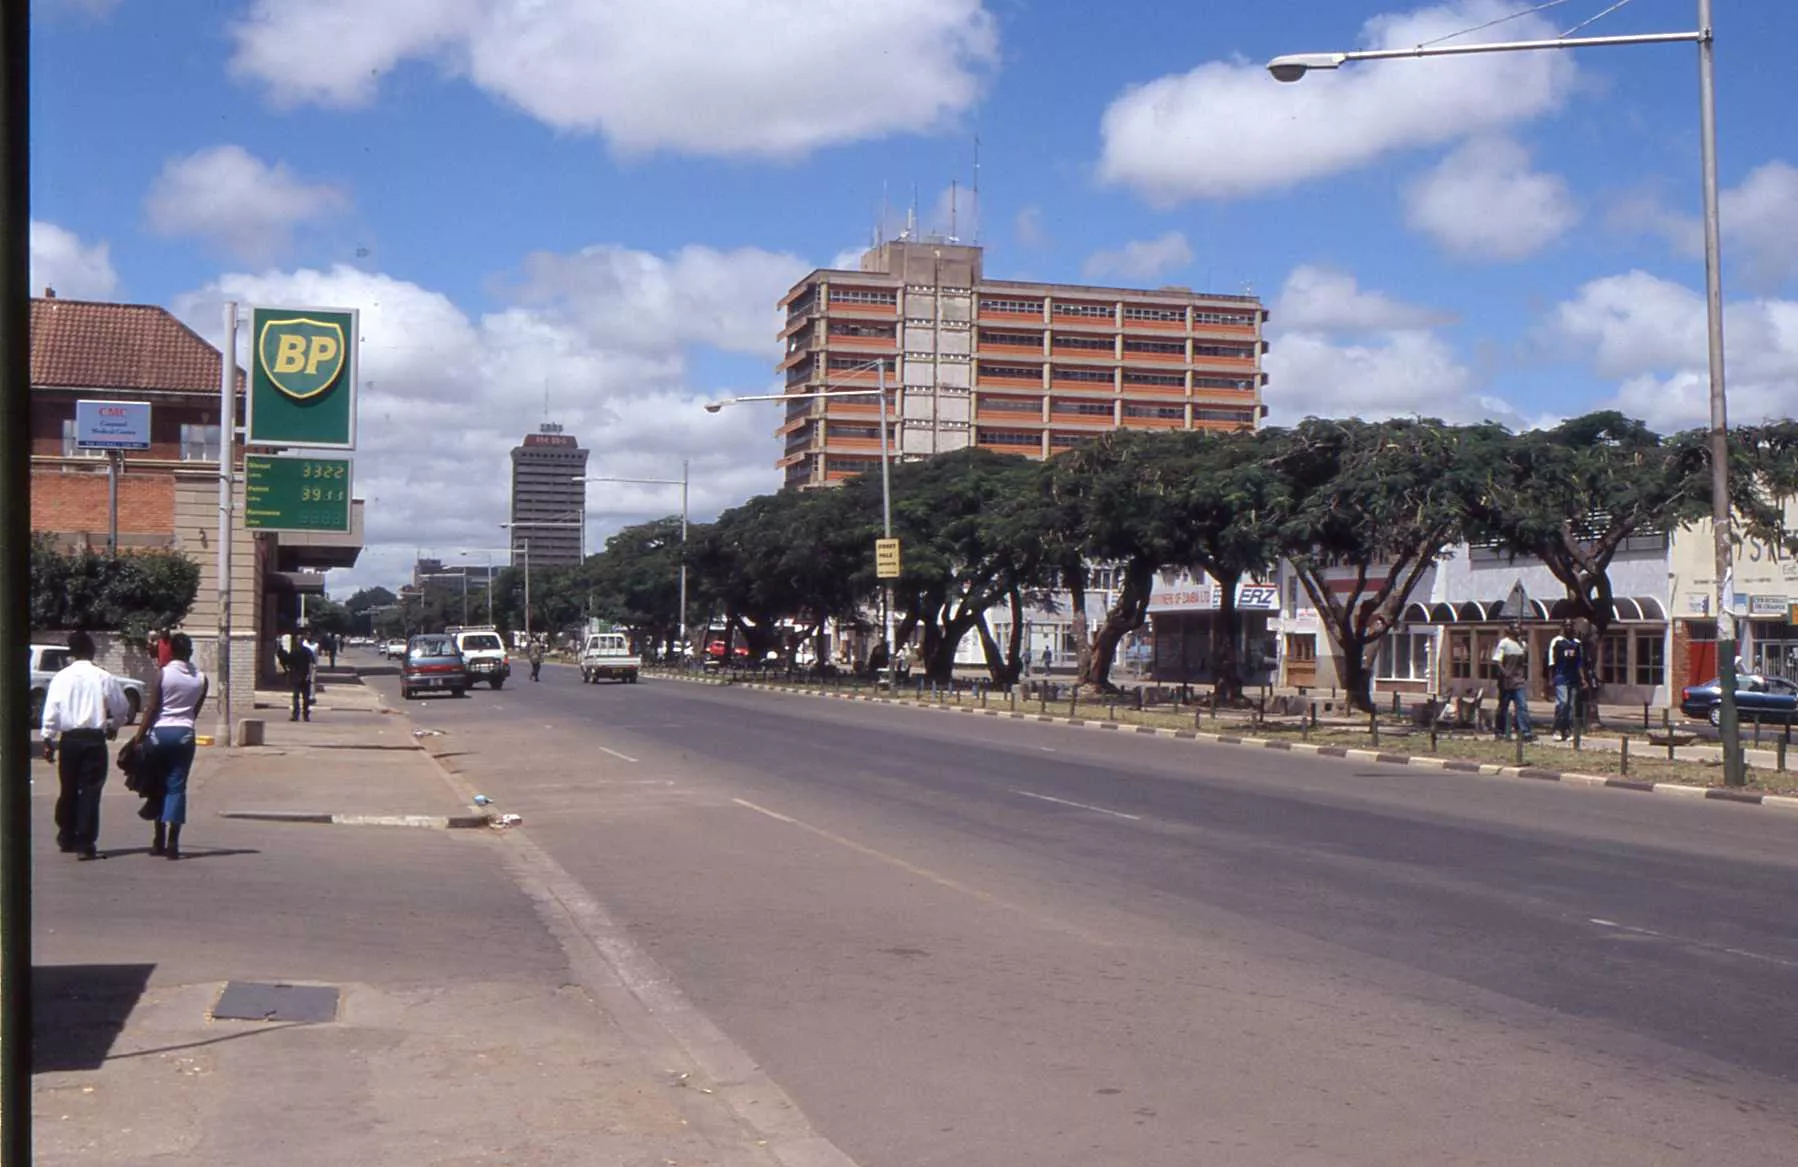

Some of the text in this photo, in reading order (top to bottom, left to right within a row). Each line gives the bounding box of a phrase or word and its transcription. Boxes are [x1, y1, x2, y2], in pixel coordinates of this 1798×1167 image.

[273, 334, 337, 375] BP
[303, 463, 344, 479] 3322
[1240, 588, 1276, 604] ERZ
